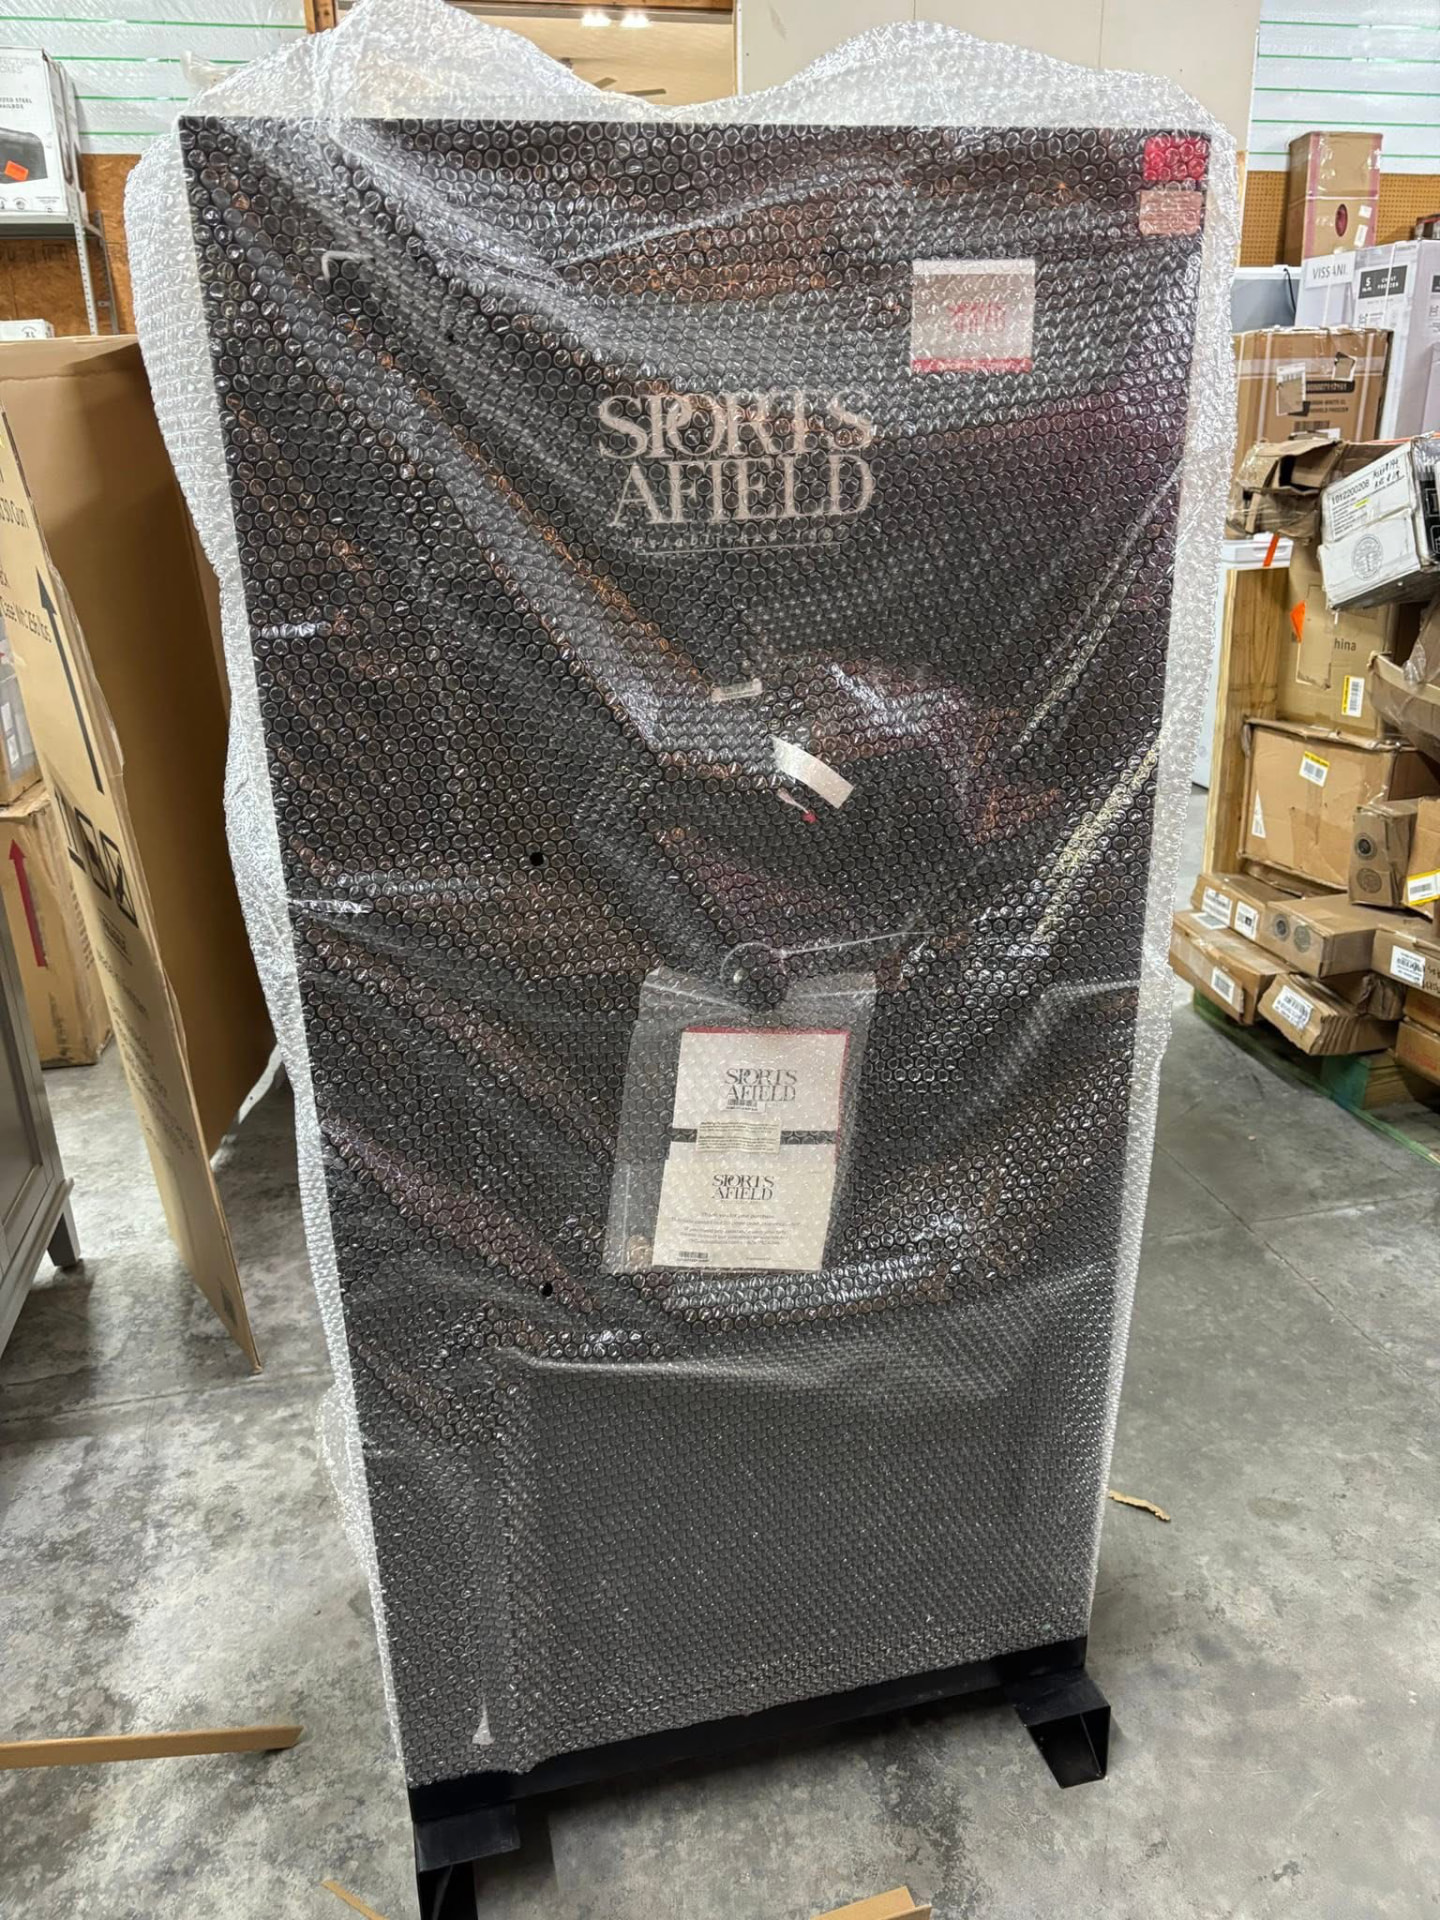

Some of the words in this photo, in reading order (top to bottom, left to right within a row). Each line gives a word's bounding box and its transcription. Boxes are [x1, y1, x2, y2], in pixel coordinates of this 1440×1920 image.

[598, 389, 874, 459] SPORTS
[605, 454, 875, 527] AFIELD
[724, 1067, 798, 1085] SPORTS
[725, 1084, 797, 1102] AFIELD
[711, 1173, 775, 1188] SPORTS
[711, 1186, 774, 1201] AFIELD
